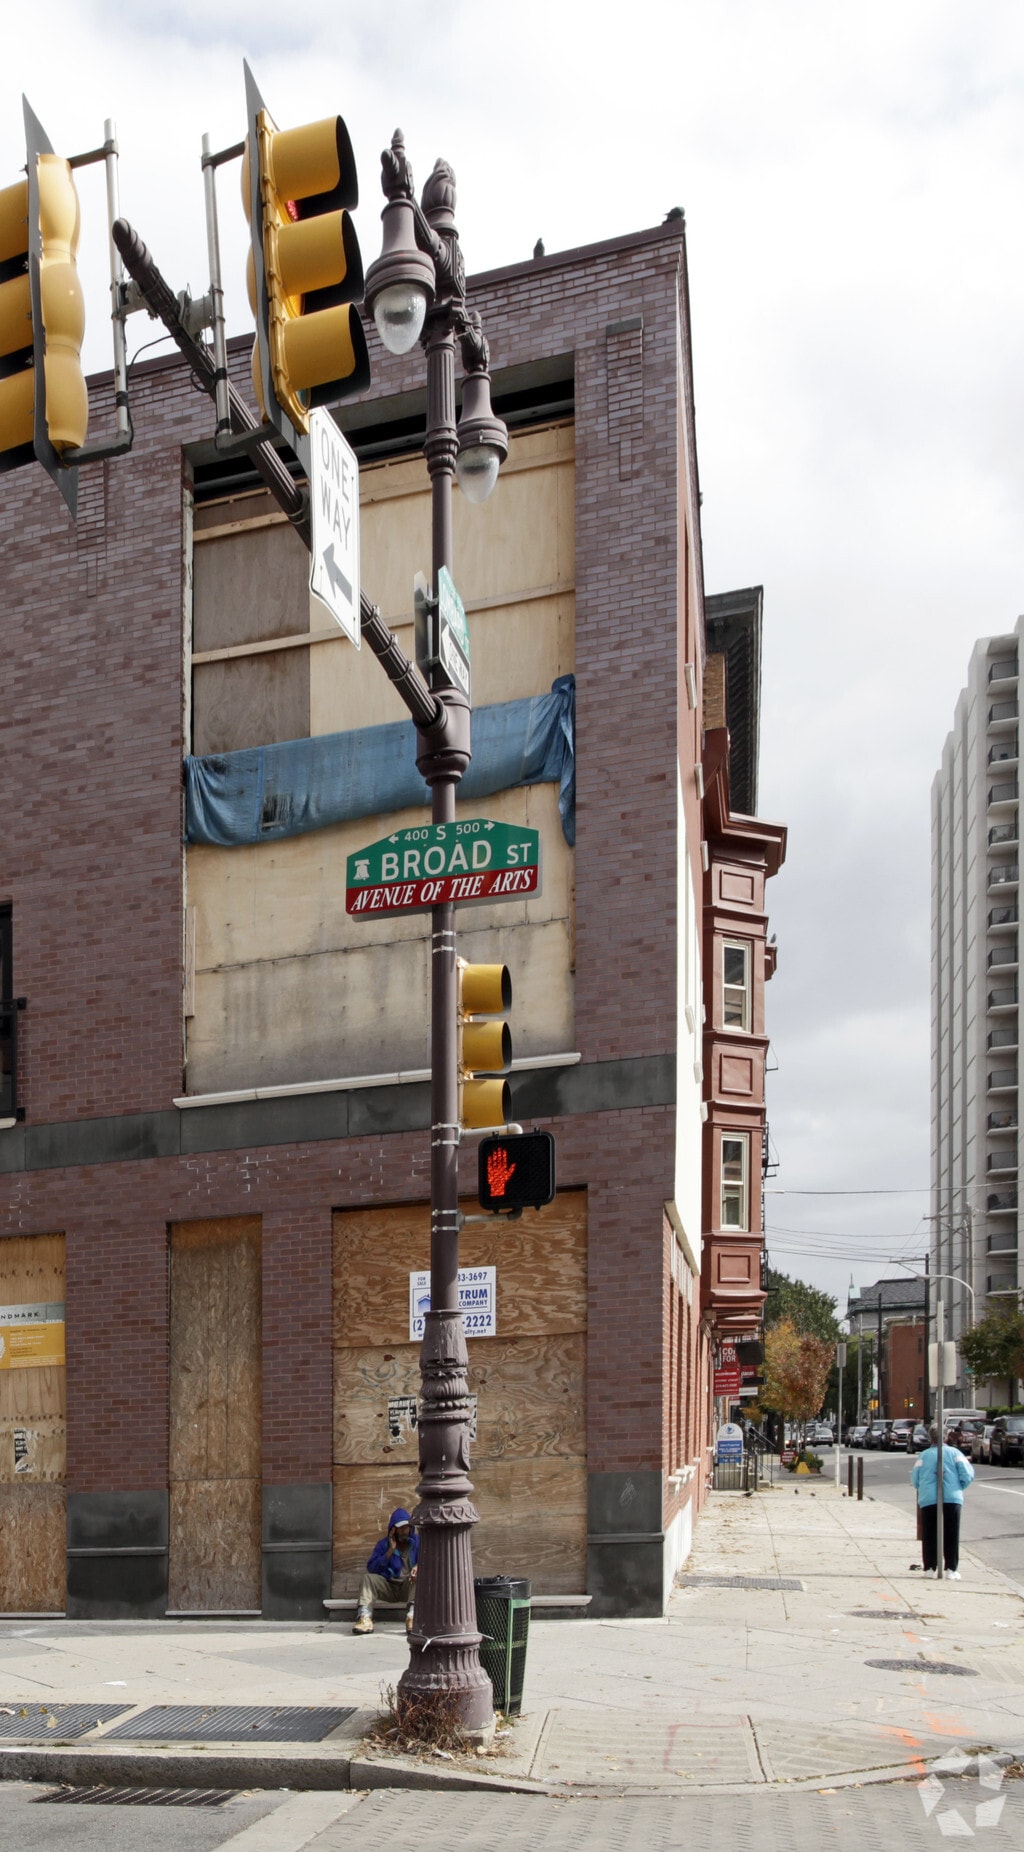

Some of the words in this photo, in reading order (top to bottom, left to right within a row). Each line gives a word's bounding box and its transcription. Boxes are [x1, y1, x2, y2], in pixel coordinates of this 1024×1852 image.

[320, 426, 350, 502] ONE
[320, 474, 351, 551] WAY
[404, 829, 429, 842] 400
[436, 825, 446, 840] S
[456, 822, 480, 835] 500
[381, 839, 492, 881] BROAD
[506, 842, 532, 865] ST
[350, 883, 416, 911] AVENUE
[420, 880, 445, 902] OF
[449, 875, 484, 899] THE
[488, 868, 534, 894] ARTS
[458, 1272, 487, 1282] 3-3697
[458, 1299, 488, 1307] COMPANY
[459, 1288, 488, 1300] TRUM
[462, 1314, 492, 1328] -2222
